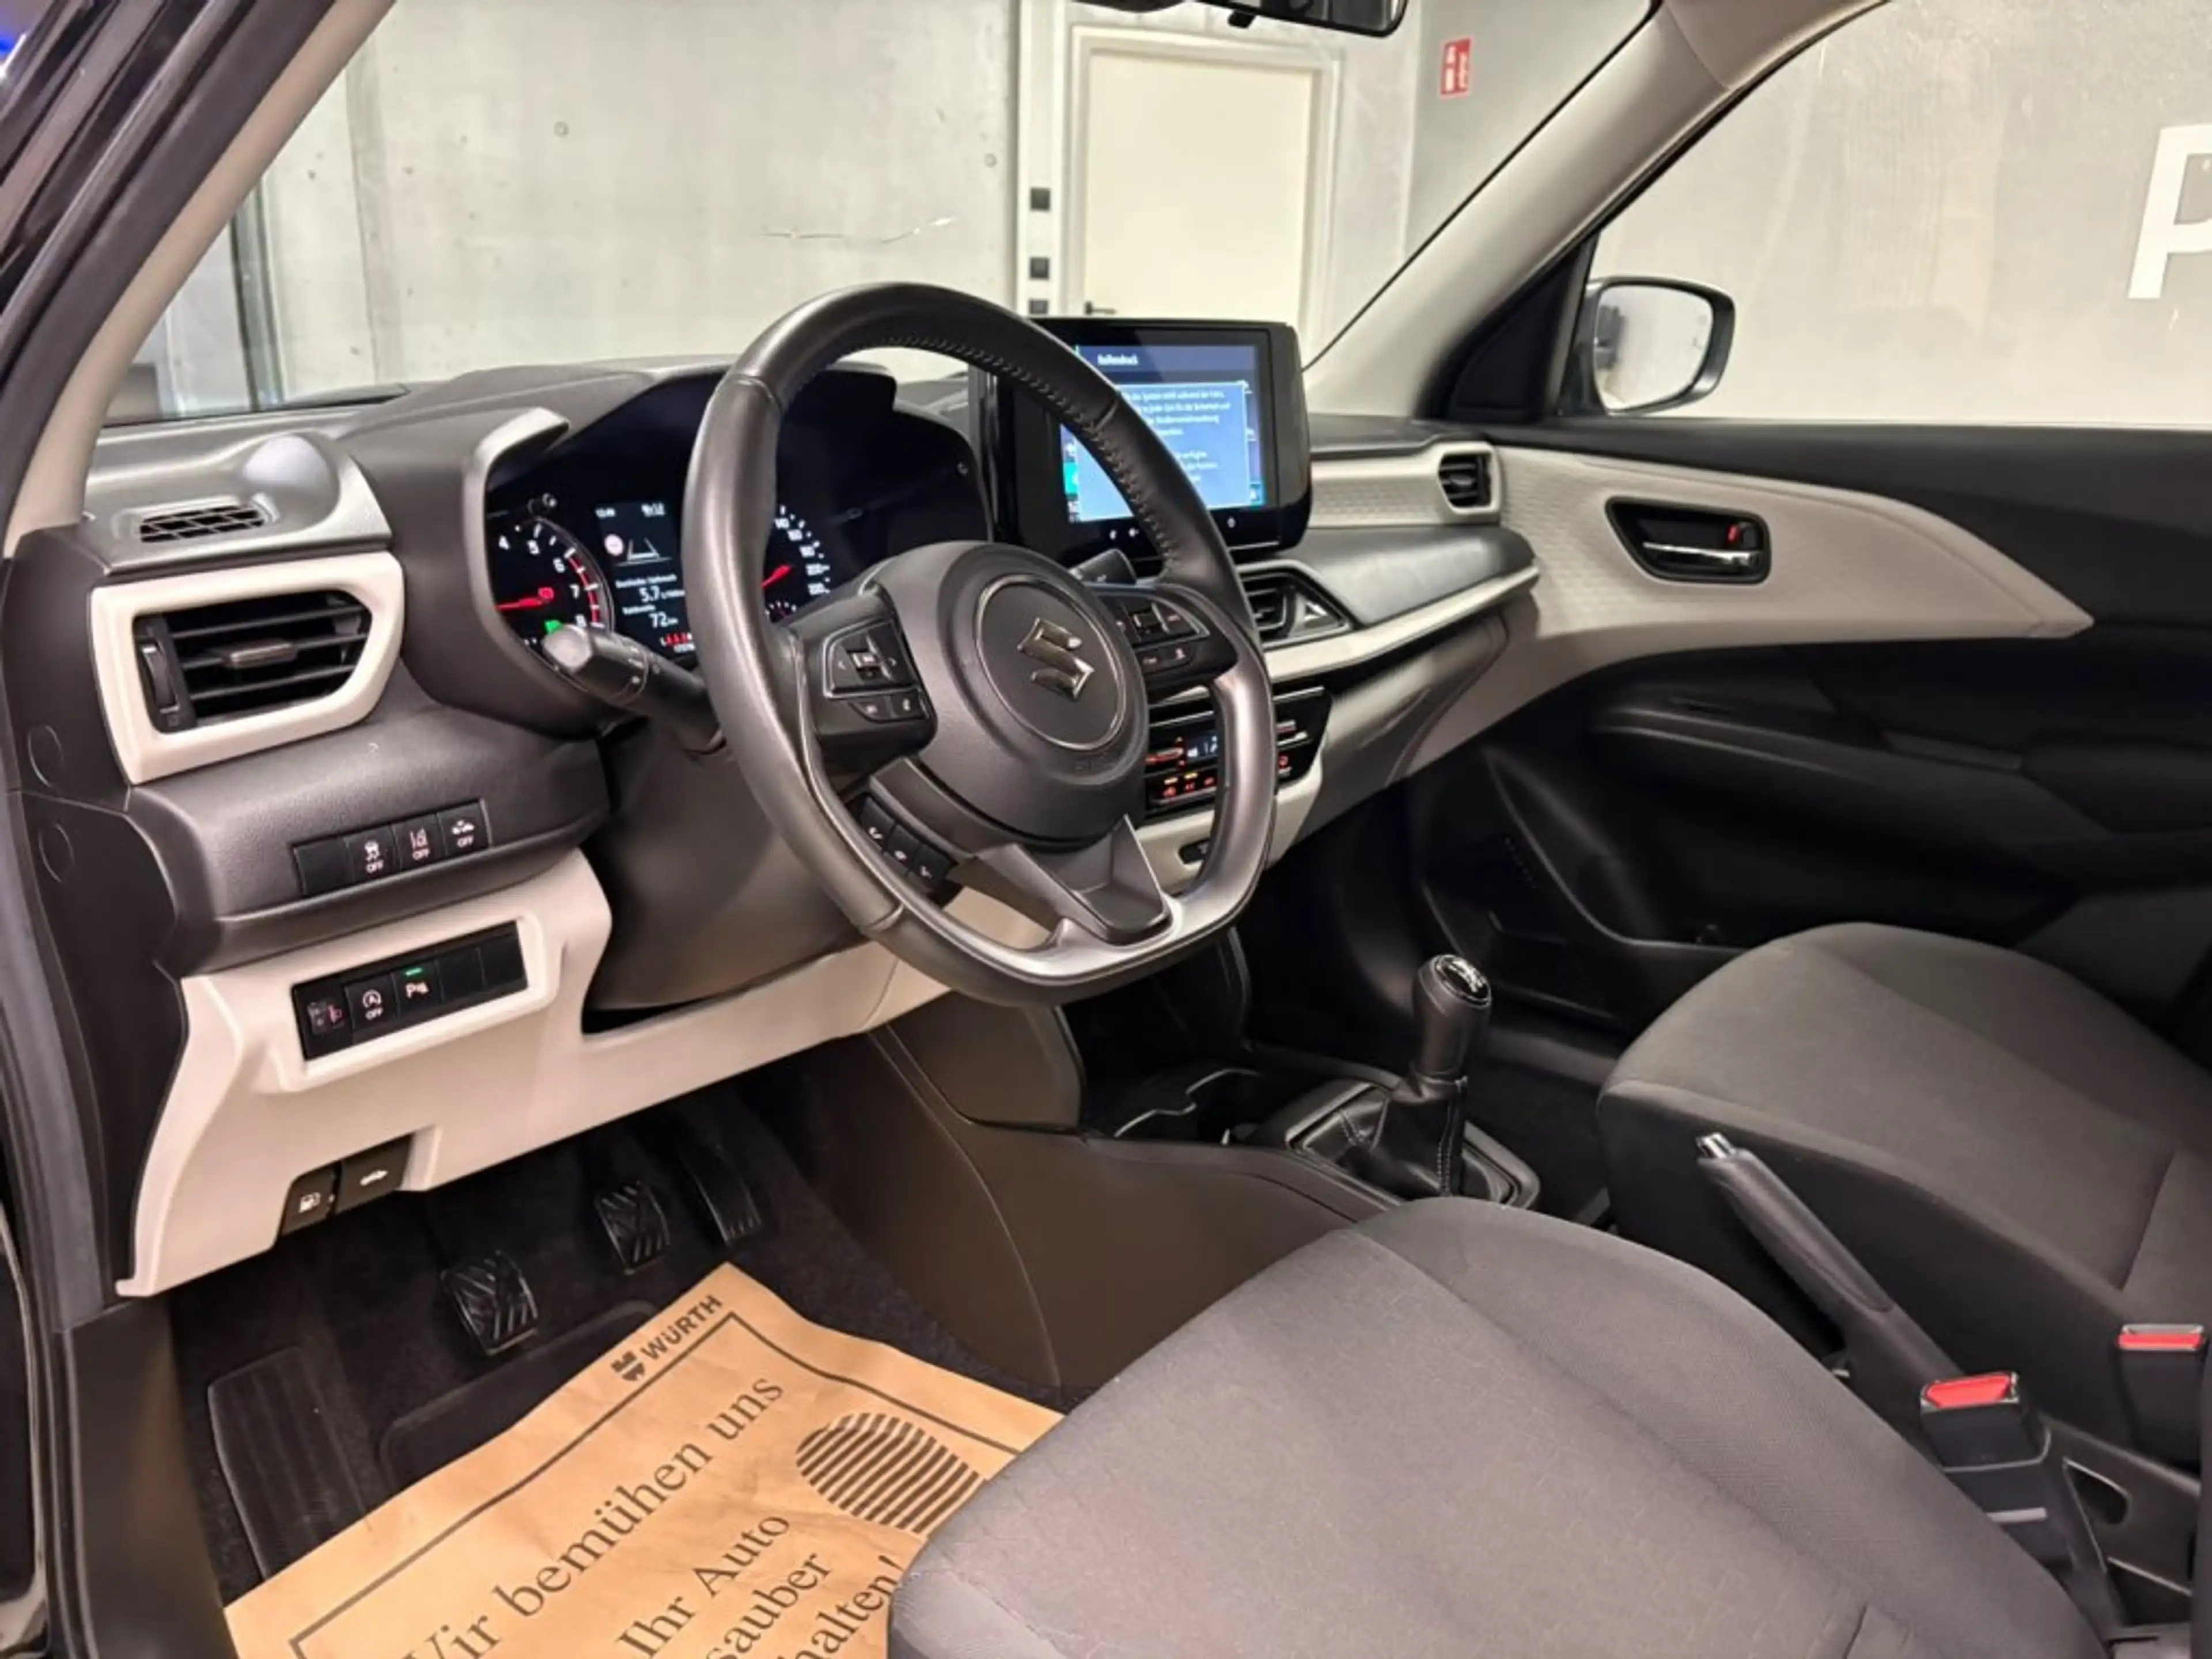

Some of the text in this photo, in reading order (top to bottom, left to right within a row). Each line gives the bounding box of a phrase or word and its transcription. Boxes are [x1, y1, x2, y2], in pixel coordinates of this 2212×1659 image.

[499, 535, 510, 550] 4
[527, 539, 540, 555] 5
[553, 558, 566, 573] 6
[570, 584, 579, 599] 7
[457, 835, 474, 848] OFF
[412, 848, 430, 861] OFF
[366, 859, 384, 873] OFF
[490, 1442, 714, 1616] bemühen
[706, 1378, 784, 1440] uns
[615, 1515, 790, 1659] Ihr Auto
